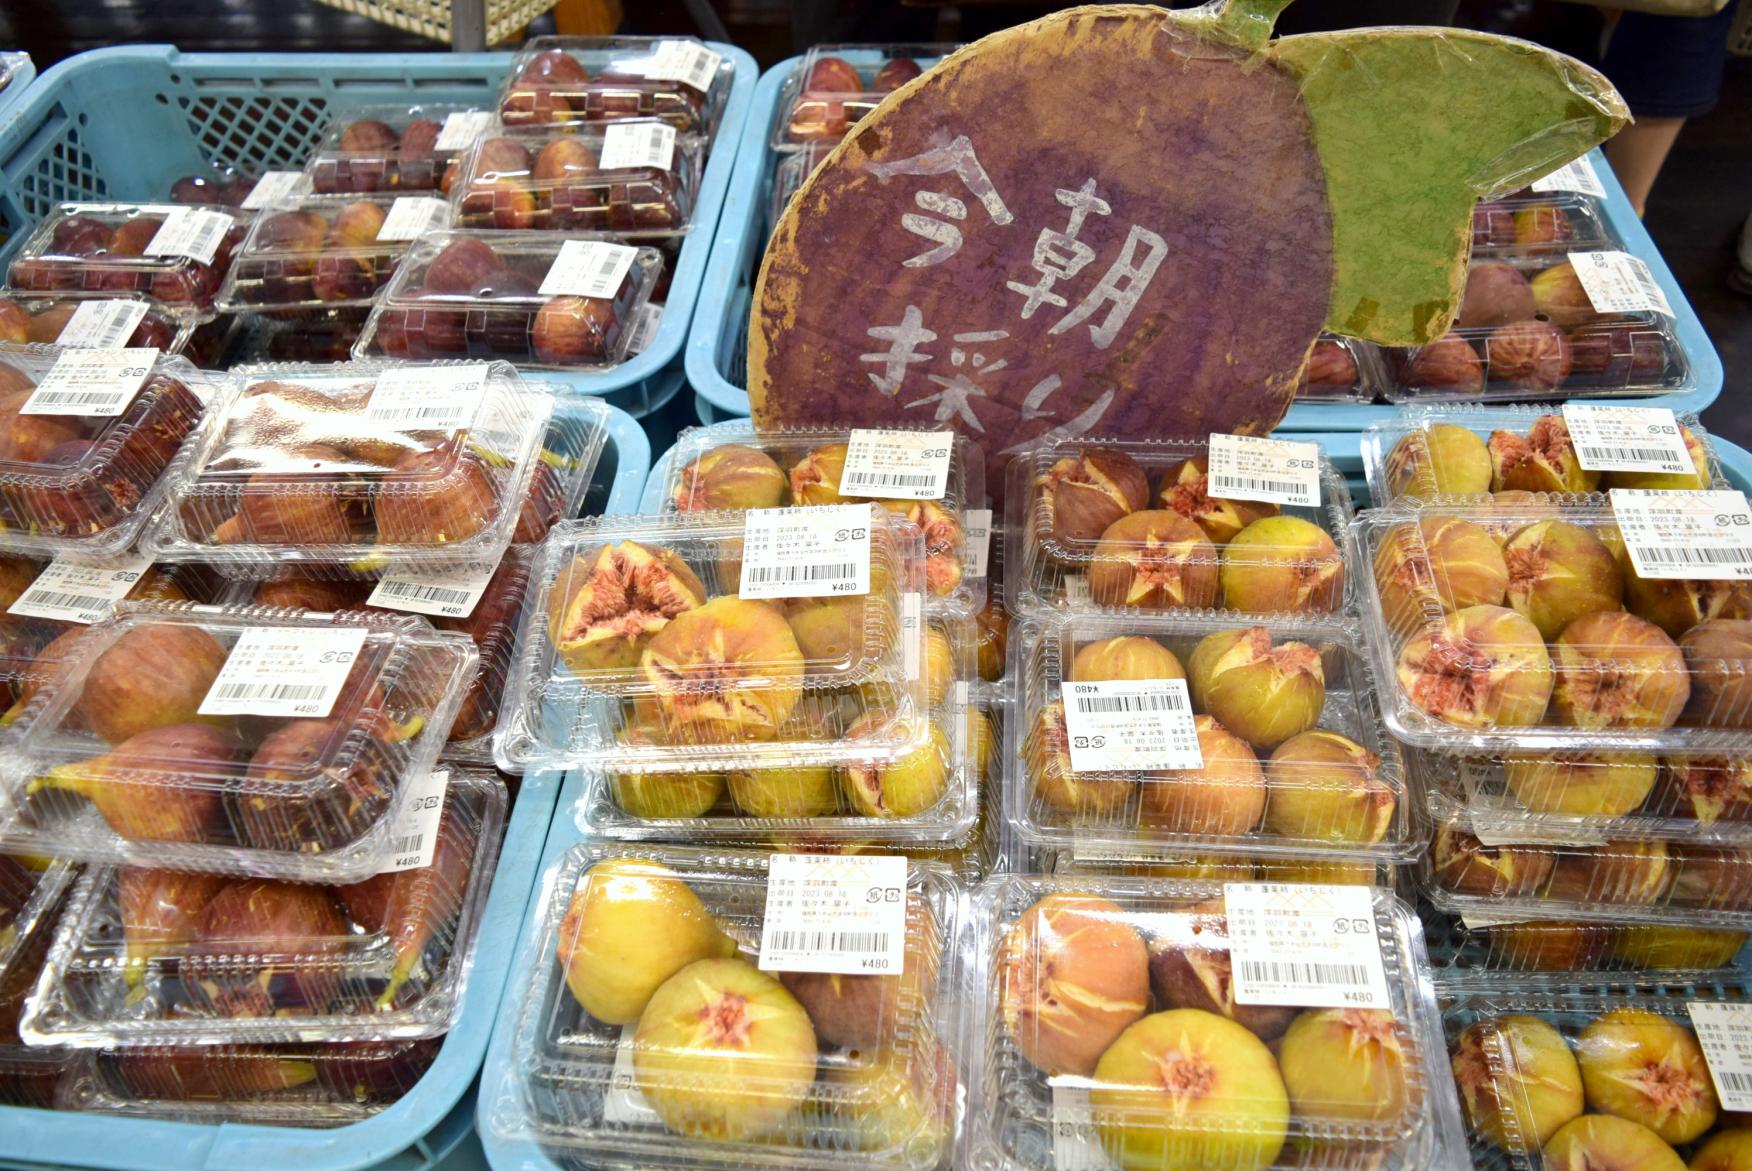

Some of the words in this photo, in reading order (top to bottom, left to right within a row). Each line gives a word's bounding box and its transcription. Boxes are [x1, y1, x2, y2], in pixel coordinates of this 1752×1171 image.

[866, 134, 1169, 350] 今朝
[859, 304, 1116, 453] 採り
[832, 583, 856, 591] ¥480
[441, 606, 462, 614] ¥480
[294, 705, 319, 713] ¥480
[396, 856, 420, 867] ¥480
[862, 959, 888, 968] ¥480
[1344, 992, 1372, 1002] ¥480
